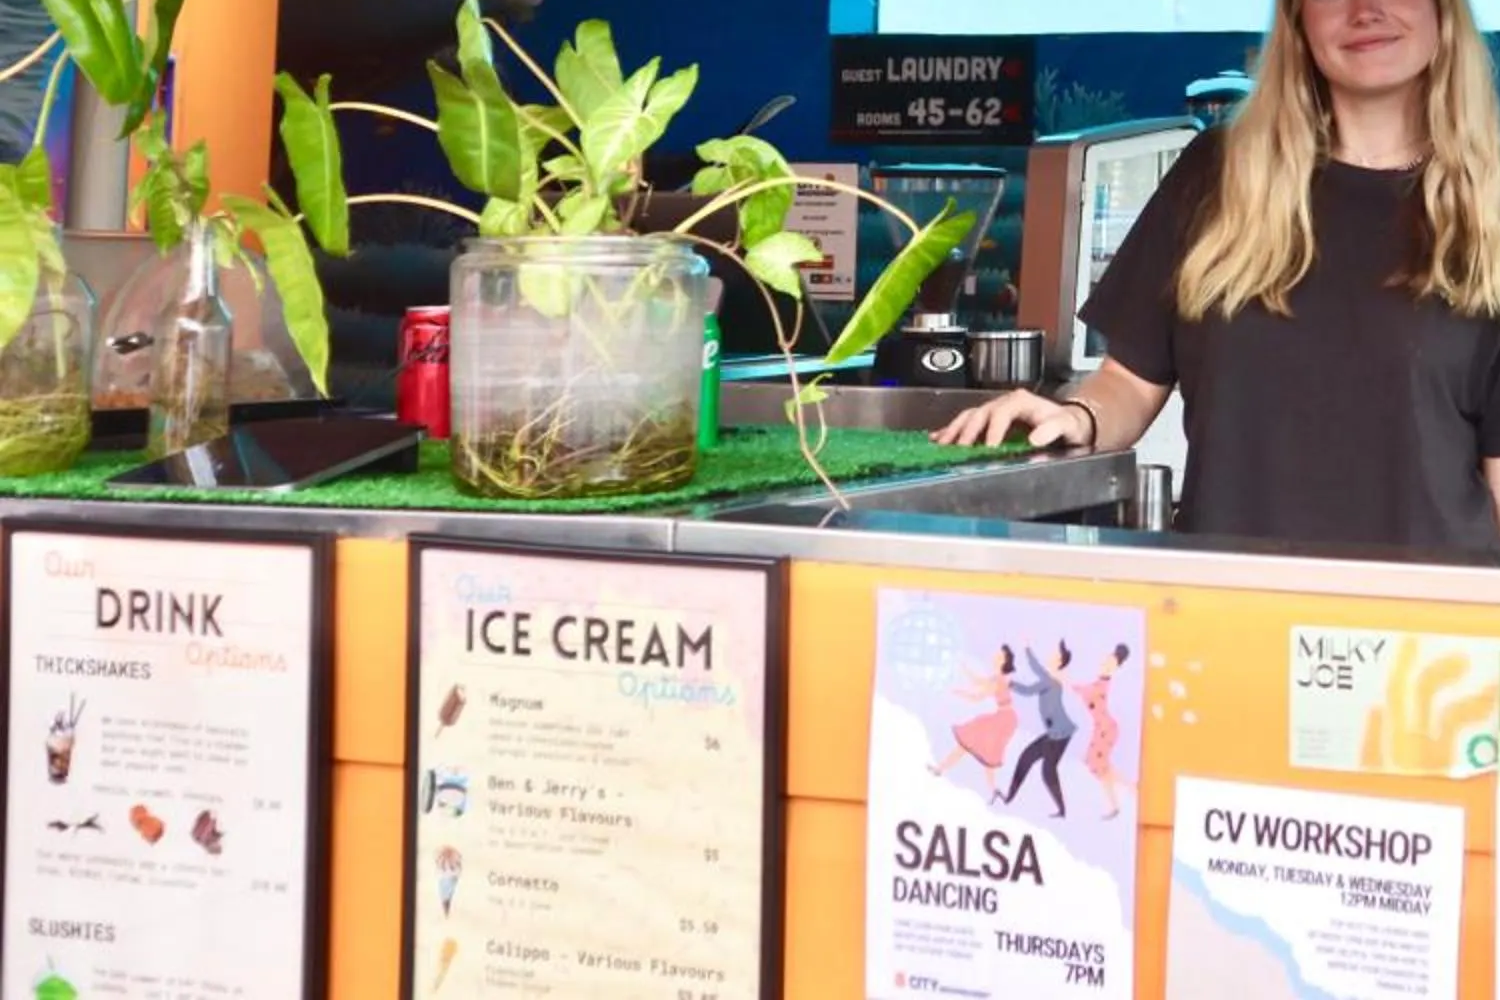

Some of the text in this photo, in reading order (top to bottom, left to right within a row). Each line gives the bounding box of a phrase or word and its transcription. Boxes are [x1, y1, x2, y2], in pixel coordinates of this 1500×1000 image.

[841, 56, 1004, 83] GUEST LAUNDRY
[856, 97, 1002, 127] ROOMS 45-62
[96, 586, 223, 638] DRINK
[466, 608, 713, 671] ICE CREAM
[1297, 634, 1386, 663] MILKY
[35, 654, 152, 681] THICKSHAKES
[1297, 664, 1354, 691] JOE
[489, 694, 544, 713] Magnum
[487, 775, 515, 791] Ben
[488, 802, 633, 828] Various Flavours
[1204, 808, 1433, 867] CV WORKSHOP
[894, 819, 1045, 887] SALSA
[487, 871, 560, 893] Cornetto
[892, 876, 999, 915] DANCING
[1273, 866, 1333, 890] TUESDAY
[1335, 873, 1345, 890] &
[1348, 875, 1433, 901] WEDNESDAY
[1340, 891, 1432, 917] 12PM MIDDAY
[28, 917, 117, 944] SLUSHIES
[993, 930, 1106, 965] THURSDAYS
[486, 940, 551, 962] Calippo
[577, 950, 642, 973] Various
[650, 958, 726, 983] Flavours
[1063, 962, 1106, 988] 7PM
[908, 974, 940, 993] CITY
